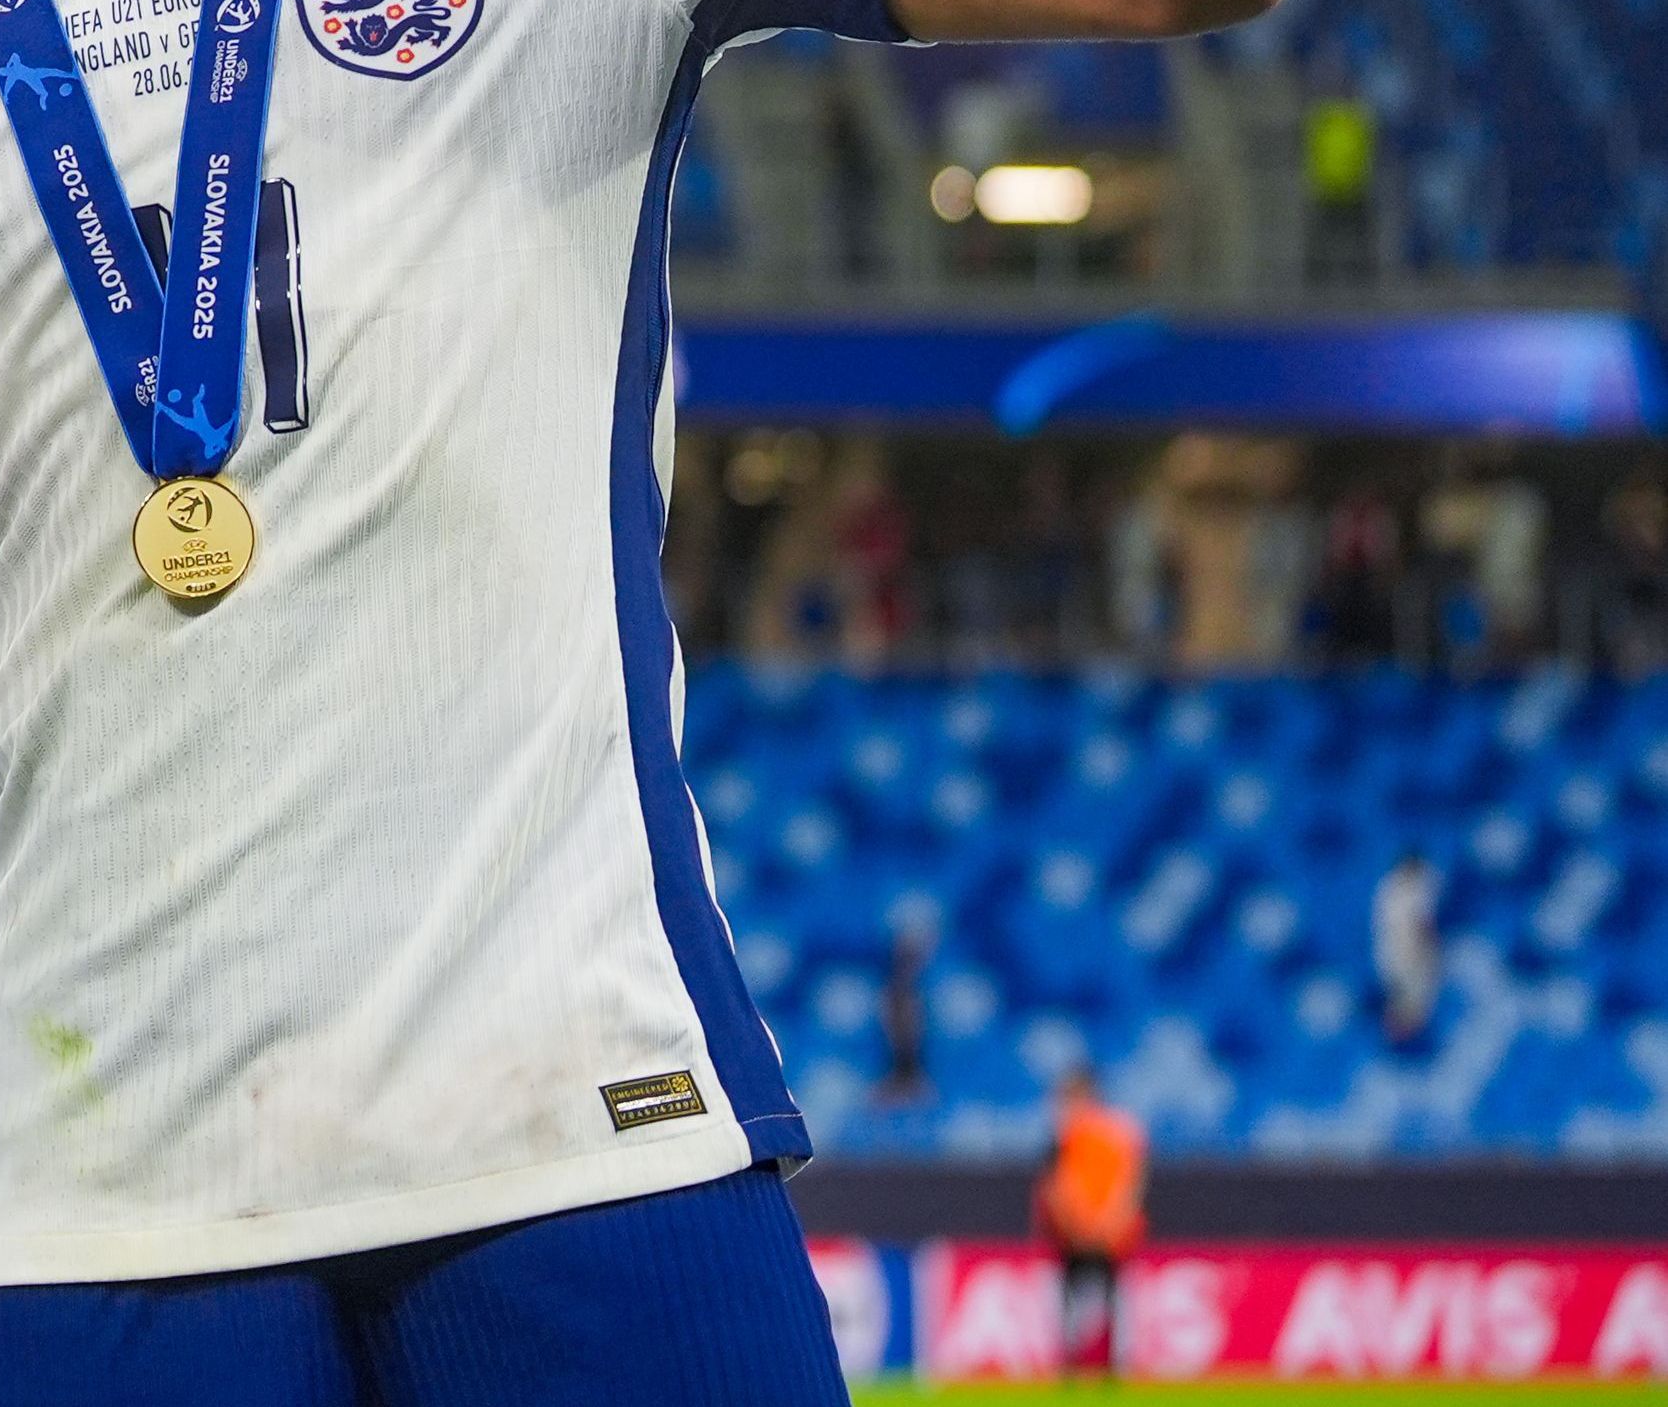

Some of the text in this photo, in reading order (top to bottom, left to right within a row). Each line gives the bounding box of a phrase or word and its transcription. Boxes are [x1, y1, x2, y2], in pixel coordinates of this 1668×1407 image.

[73, 31, 151, 74] NGLAND
[159, 34, 169, 53] v
[209, 40, 226, 104] CHAMPIONSHIP
[219, 38, 240, 104] UNDER21
[53, 144, 133, 314] SLOVAKIA 2025
[192, 153, 231, 341] SLOVAKIA 2025
[162, 551, 232, 571] UNDER21
[164, 565, 234, 583] CHAMPIONSHIP
[1268, 1257, 1566, 1379] AVIS
